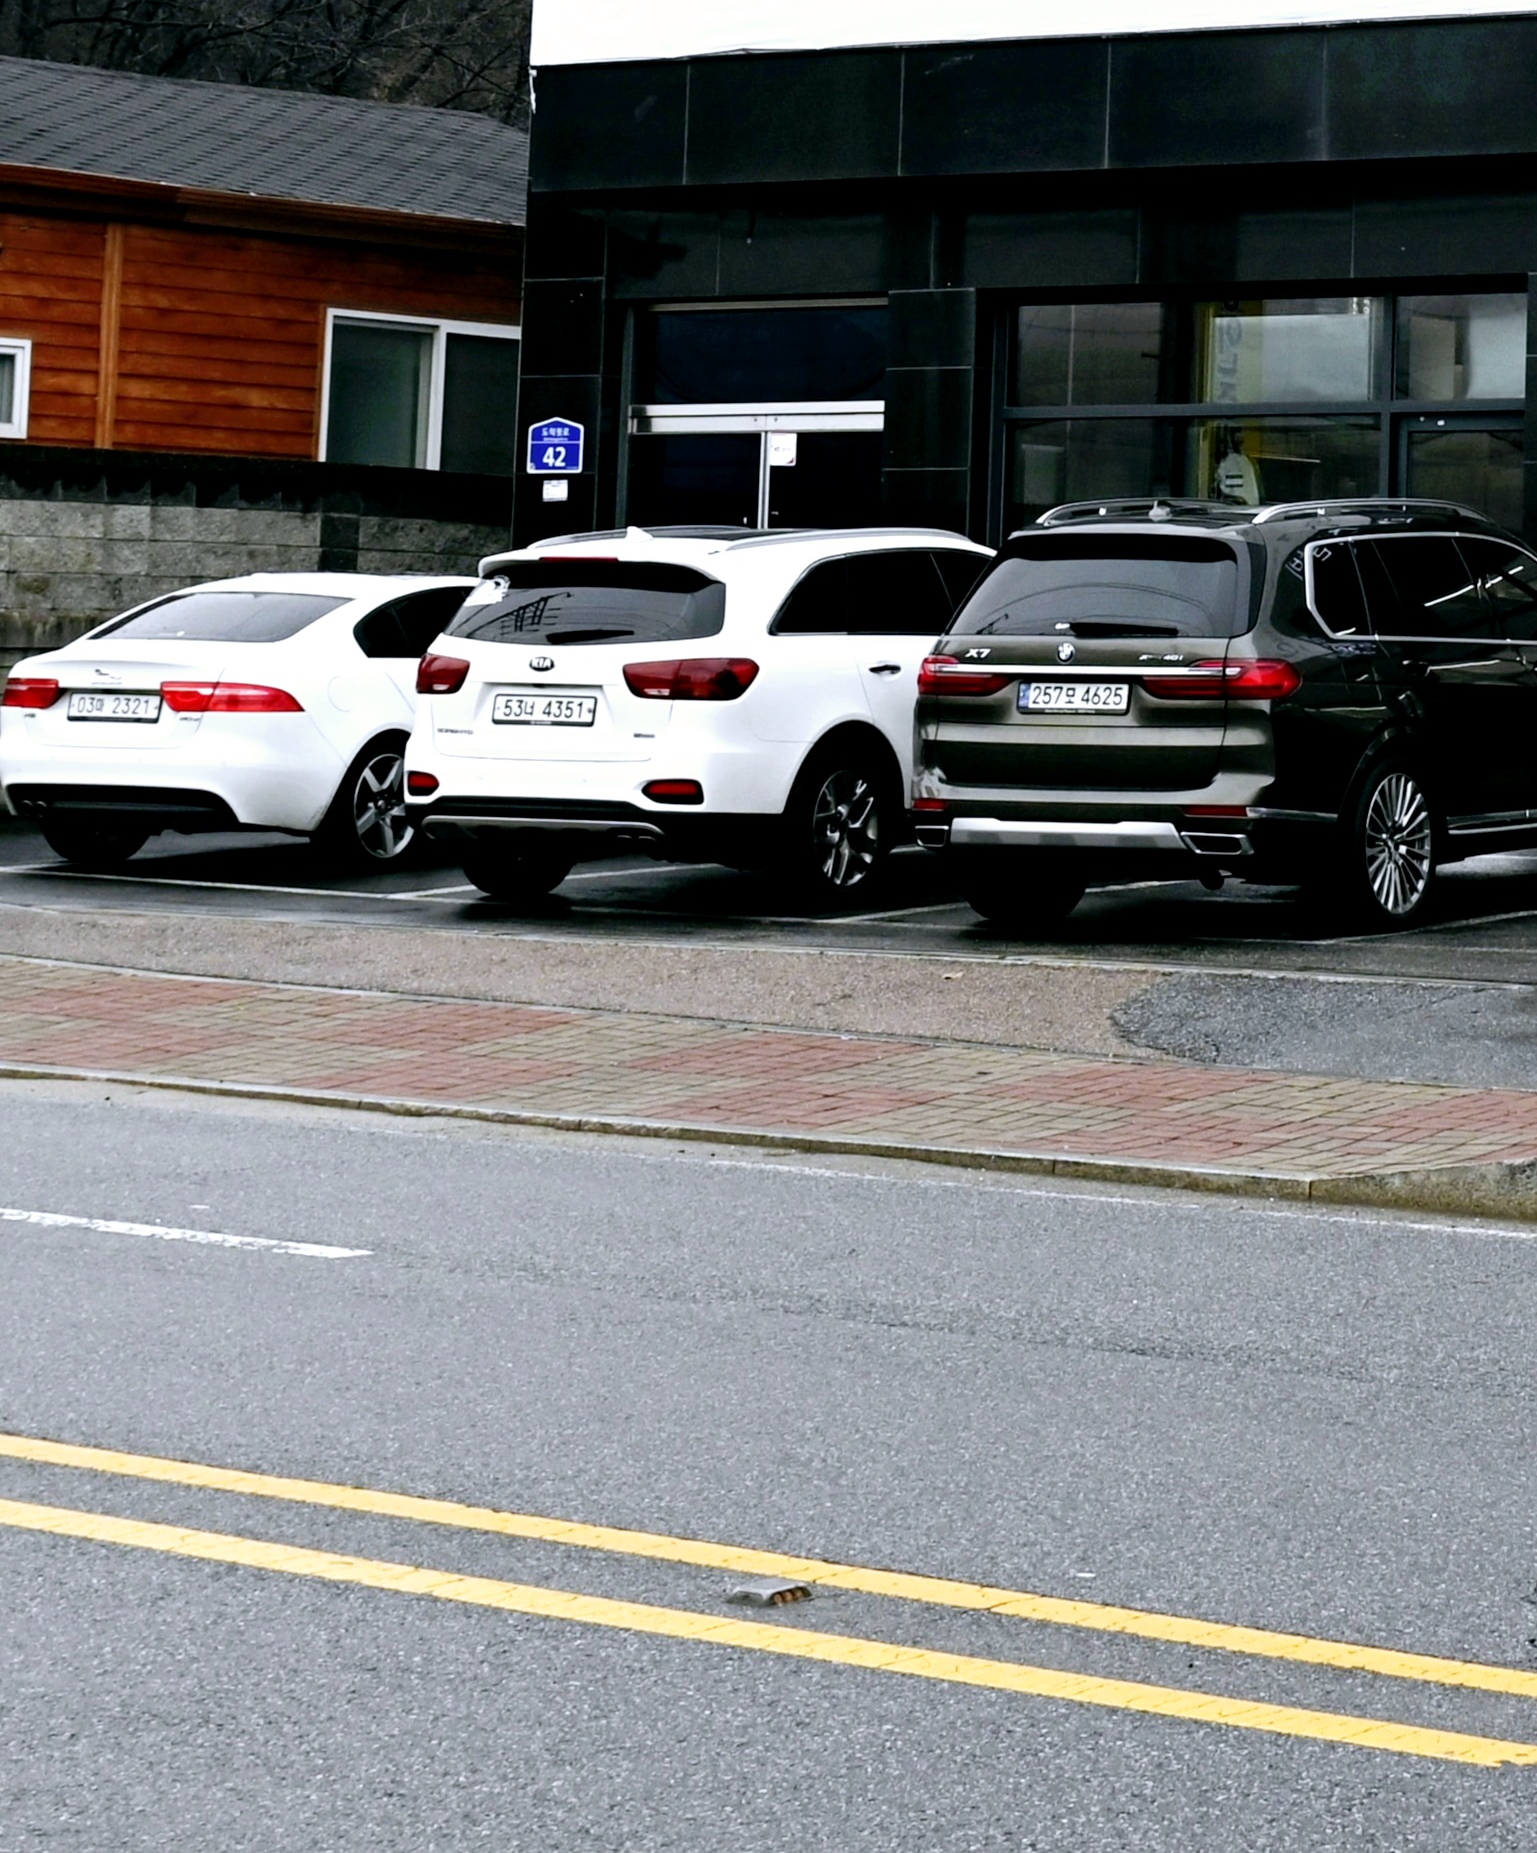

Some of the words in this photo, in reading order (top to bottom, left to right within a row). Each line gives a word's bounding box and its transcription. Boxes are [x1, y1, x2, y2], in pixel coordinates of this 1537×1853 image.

[542, 446, 566, 467] 42
[965, 648, 991, 658] X7
[531, 658, 554, 669] KIA
[1032, 685, 1076, 705] 257모
[1081, 686, 1123, 707] 4625
[111, 697, 150, 715] 2321
[542, 701, 584, 720] 4351
